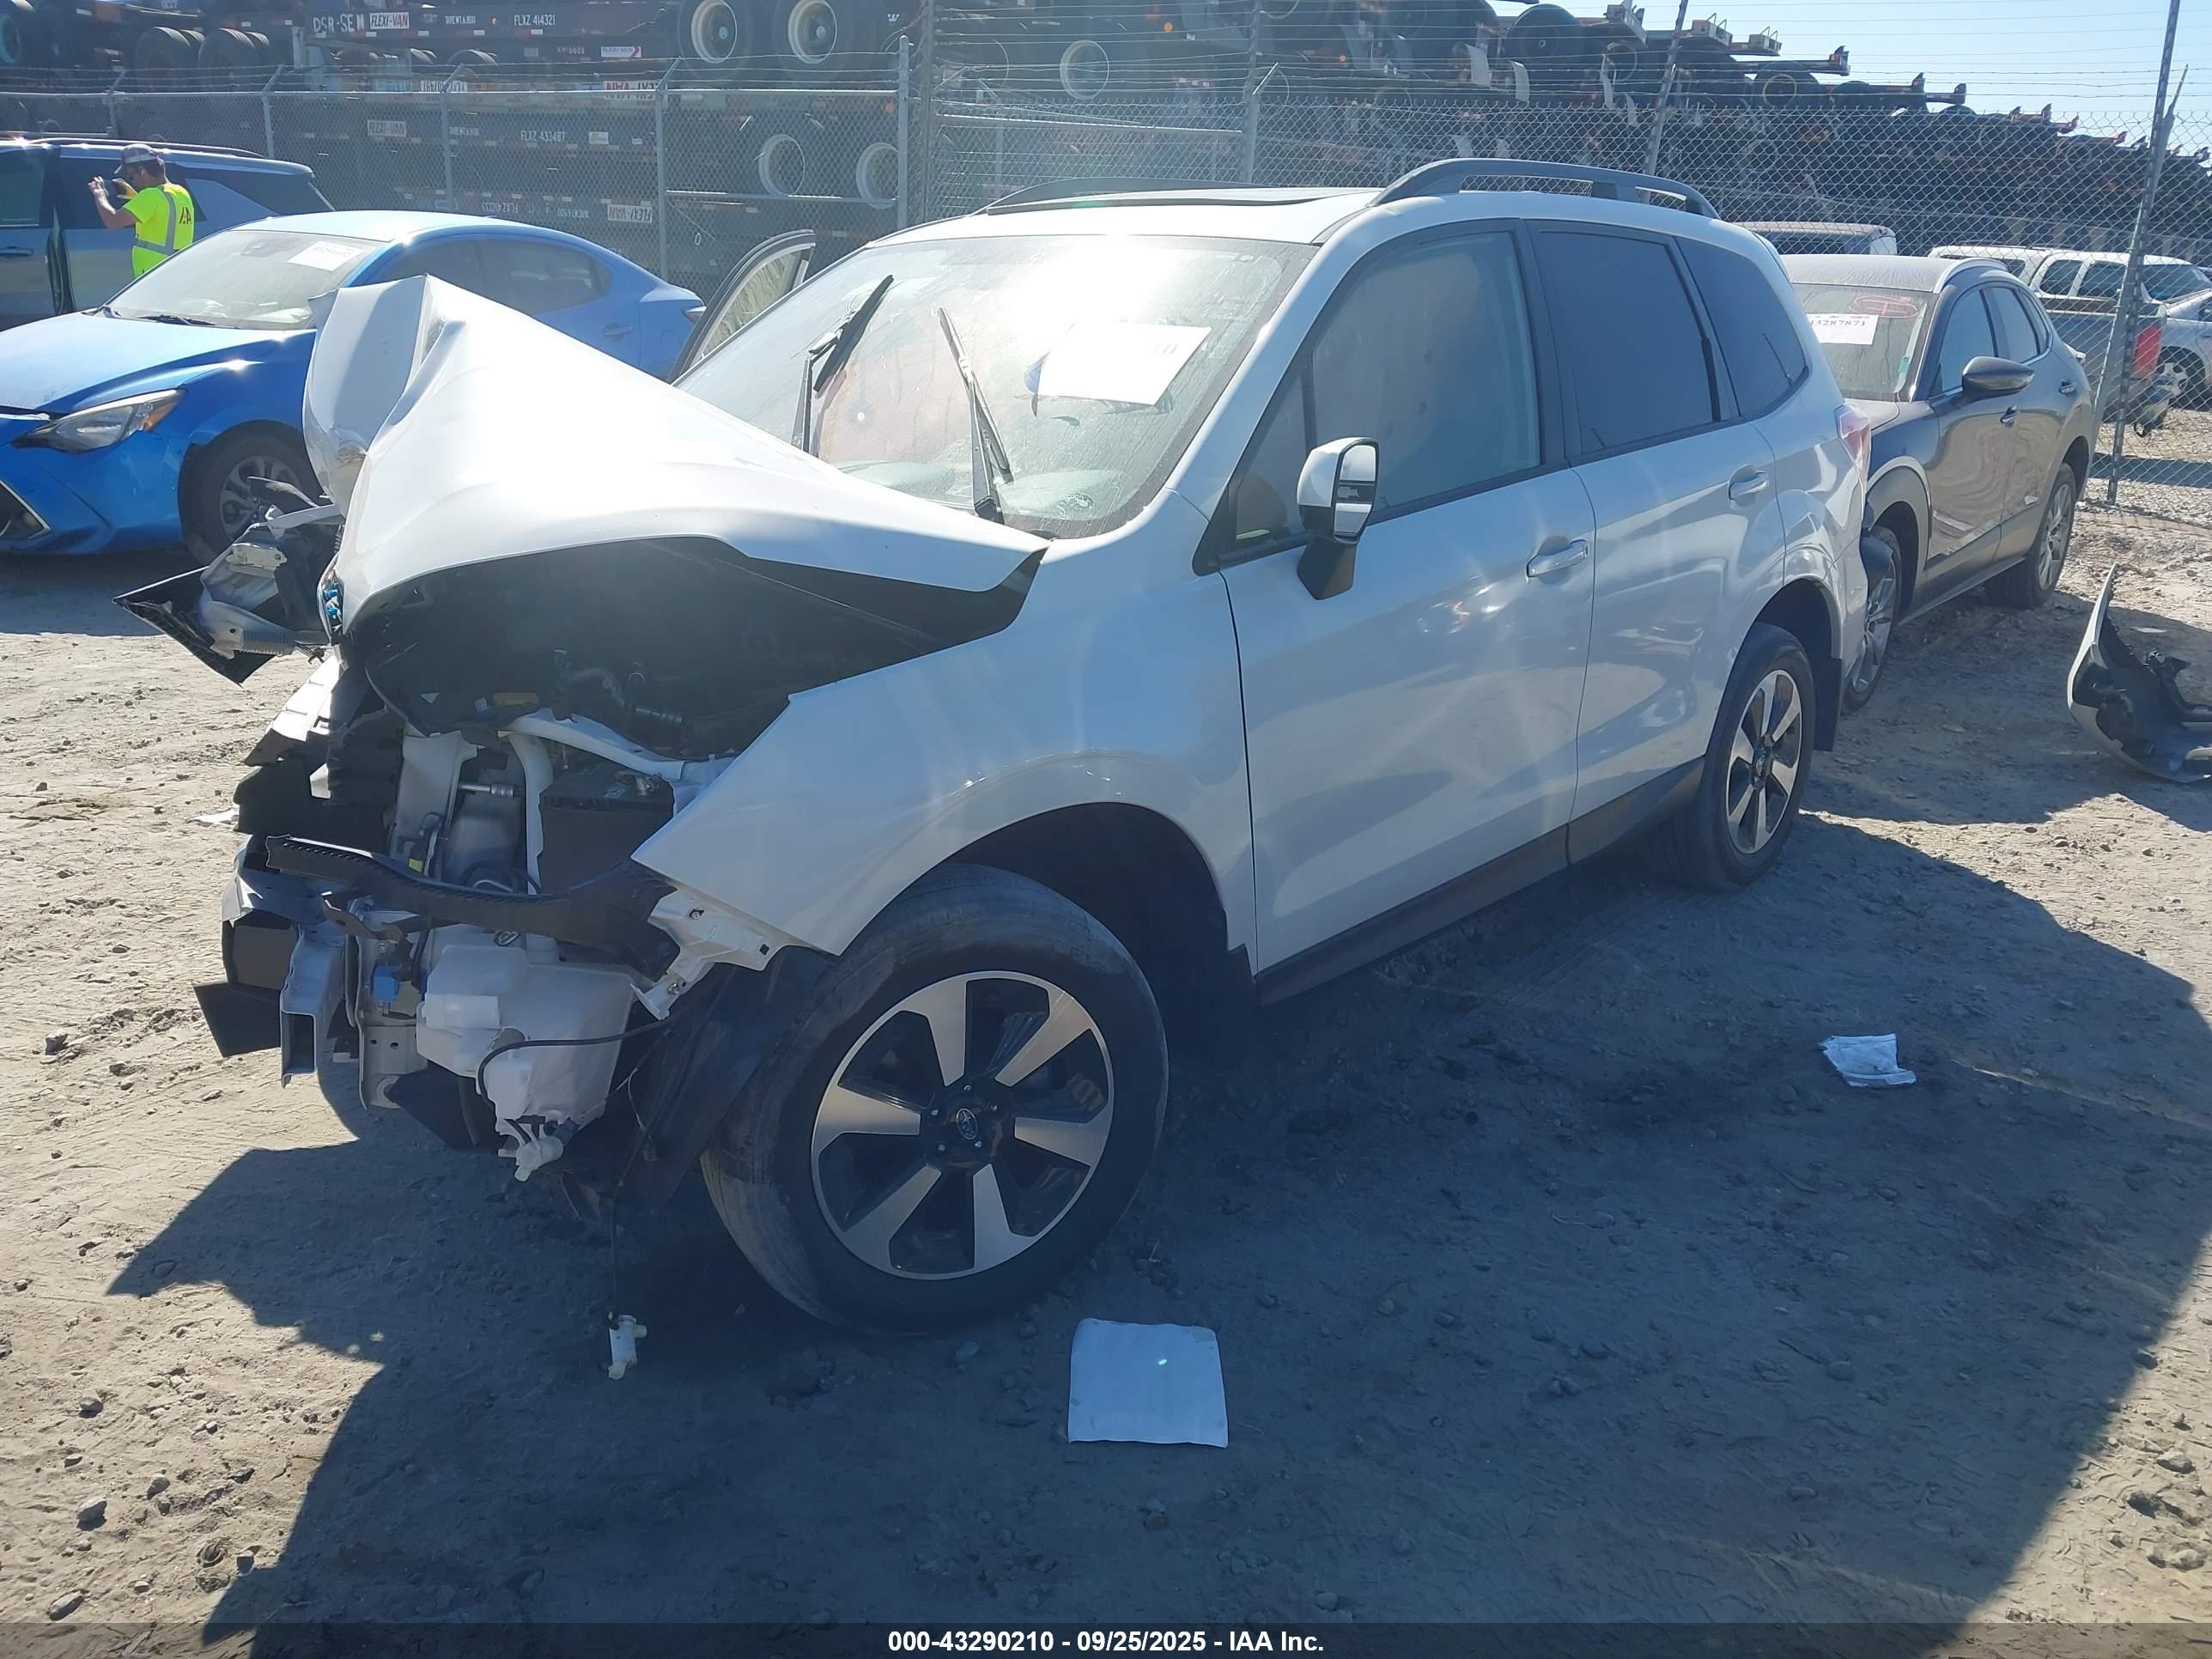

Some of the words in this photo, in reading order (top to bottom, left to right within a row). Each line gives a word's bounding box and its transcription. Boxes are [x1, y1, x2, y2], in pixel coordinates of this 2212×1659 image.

[370, 13, 409, 29] FLEXI-VAN
[514, 15, 532, 26] FLXZ
[532, 14, 556, 26] 414321
[520, 130, 538, 141] FLXZ
